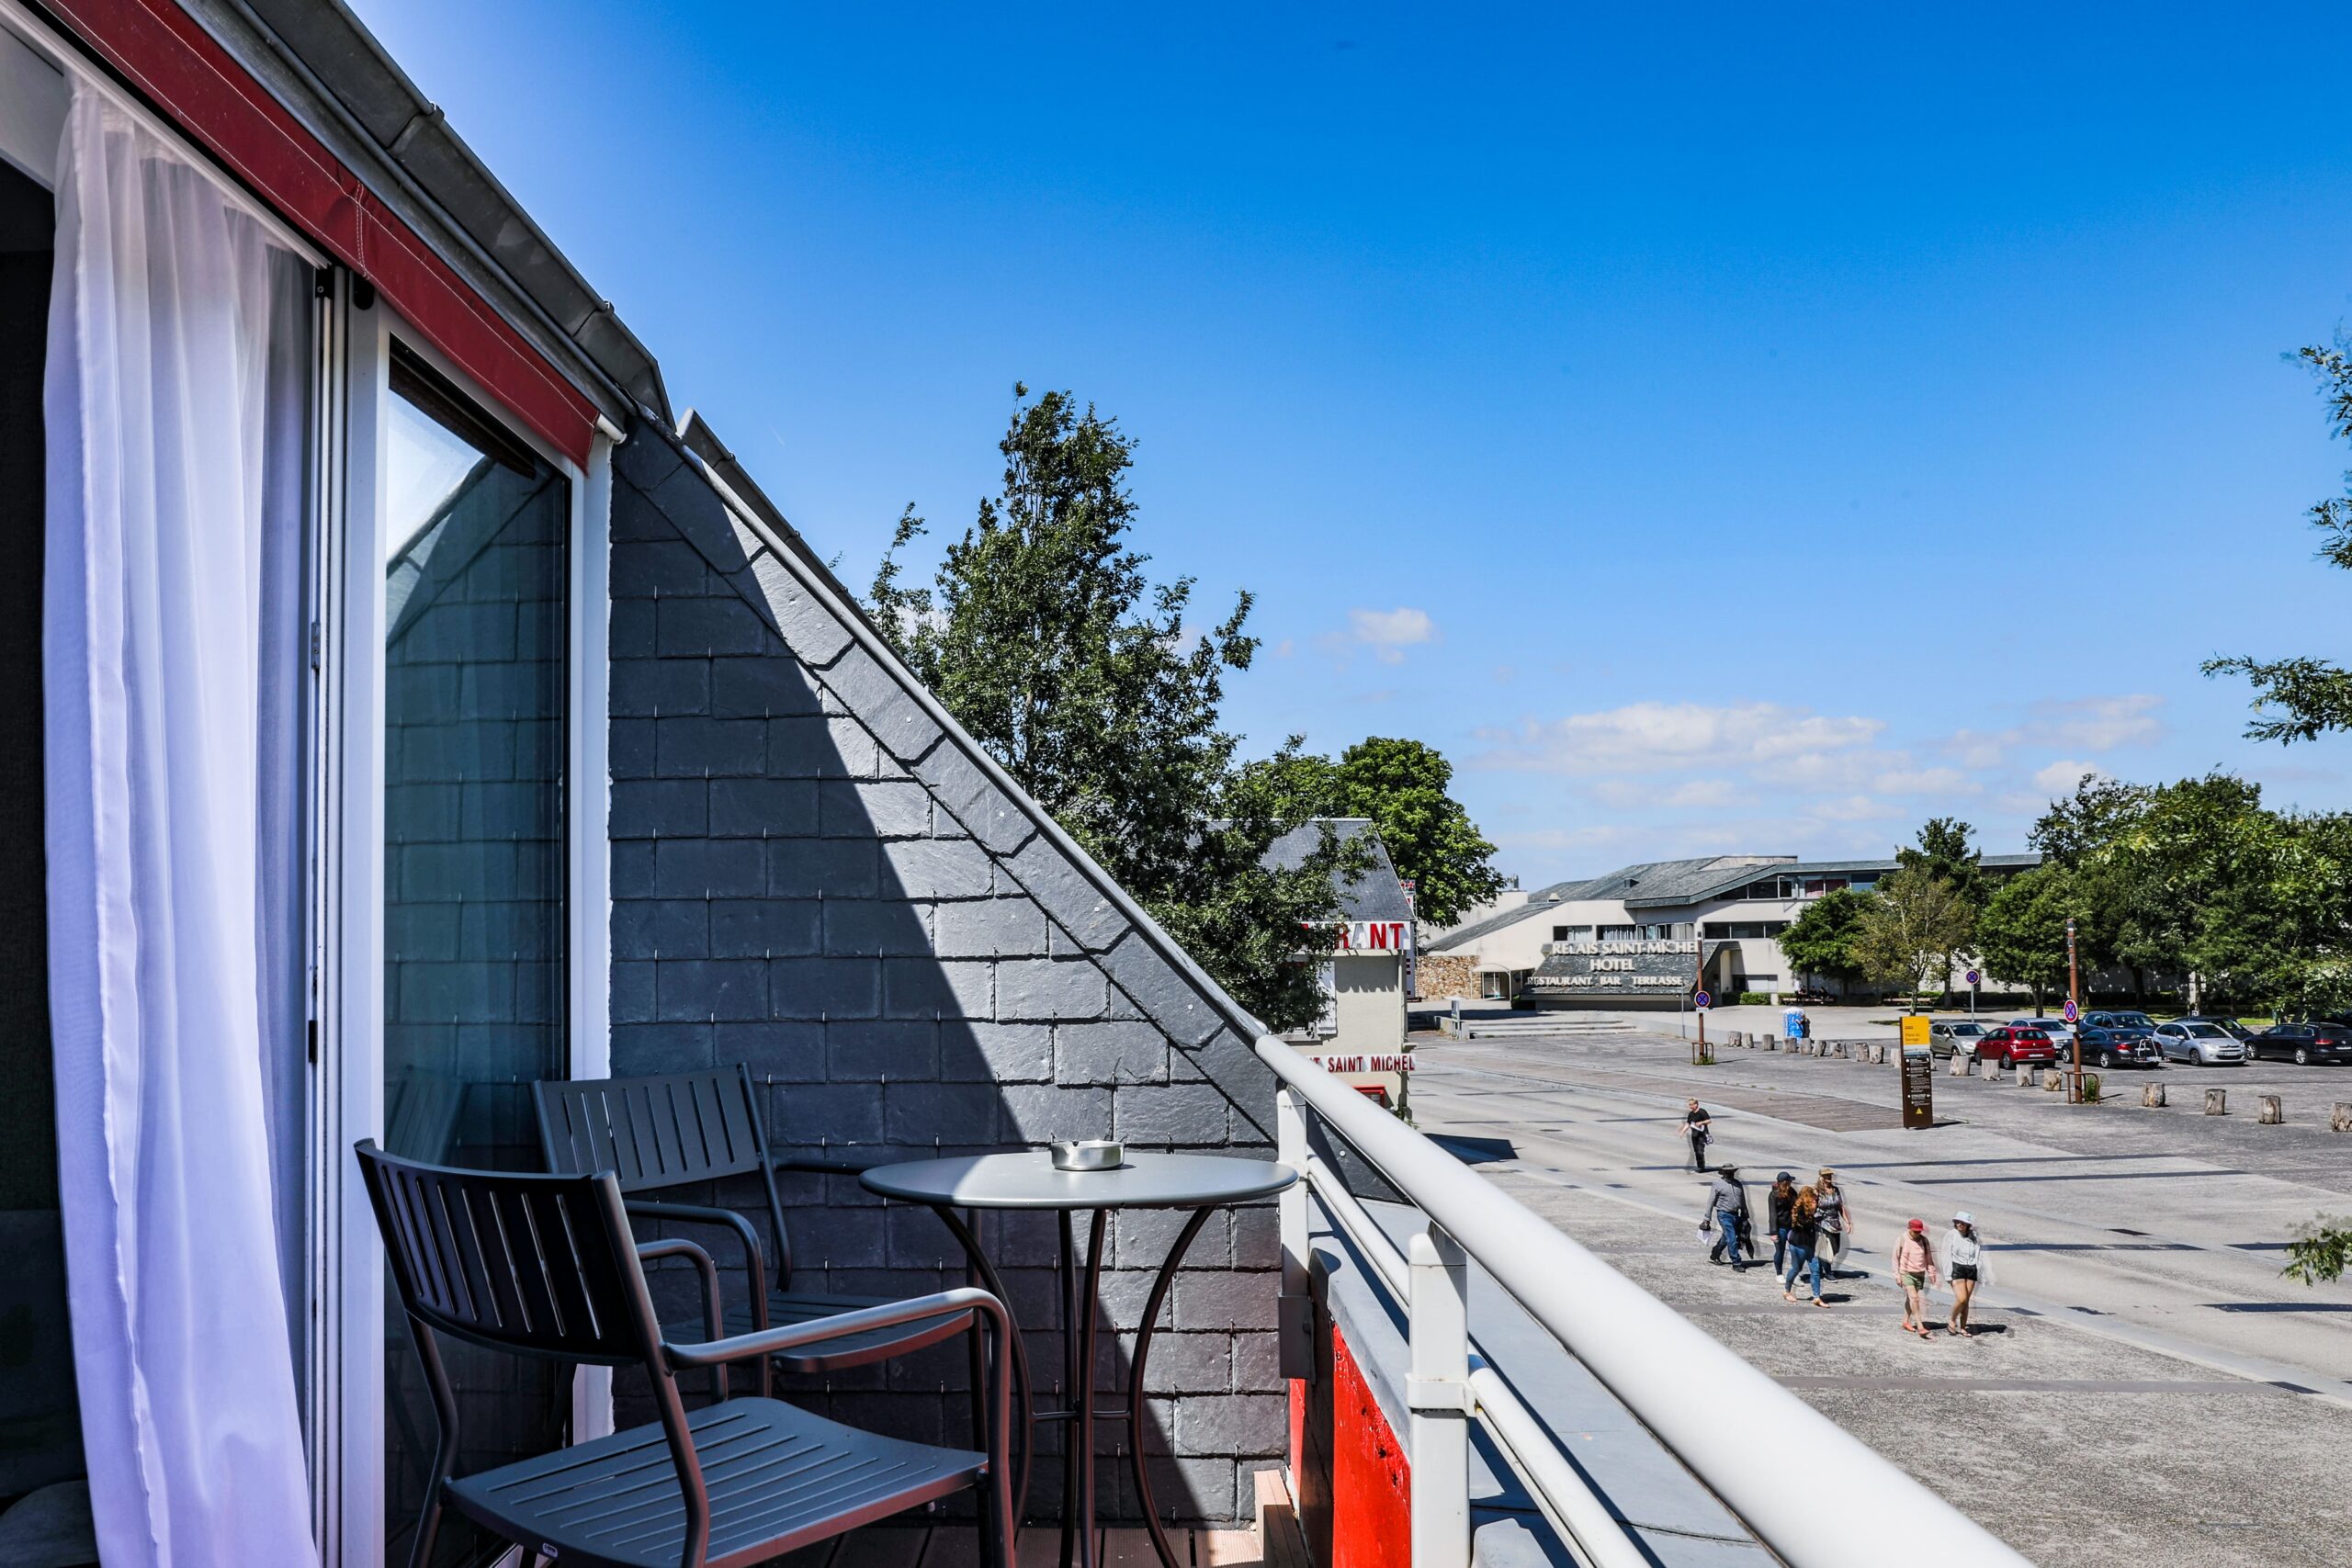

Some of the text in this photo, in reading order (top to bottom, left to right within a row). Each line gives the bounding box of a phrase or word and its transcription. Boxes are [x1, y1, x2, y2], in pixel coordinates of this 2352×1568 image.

[1552, 942, 1599, 954] RELAIS
[1589, 958, 1635, 971] HOTEL
[1527, 976, 1683, 986] RESTAURANT BAR TERRASSE
[1328, 1056, 1363, 1073] SAINT
[1371, 1055, 1415, 1072] MICHEL
